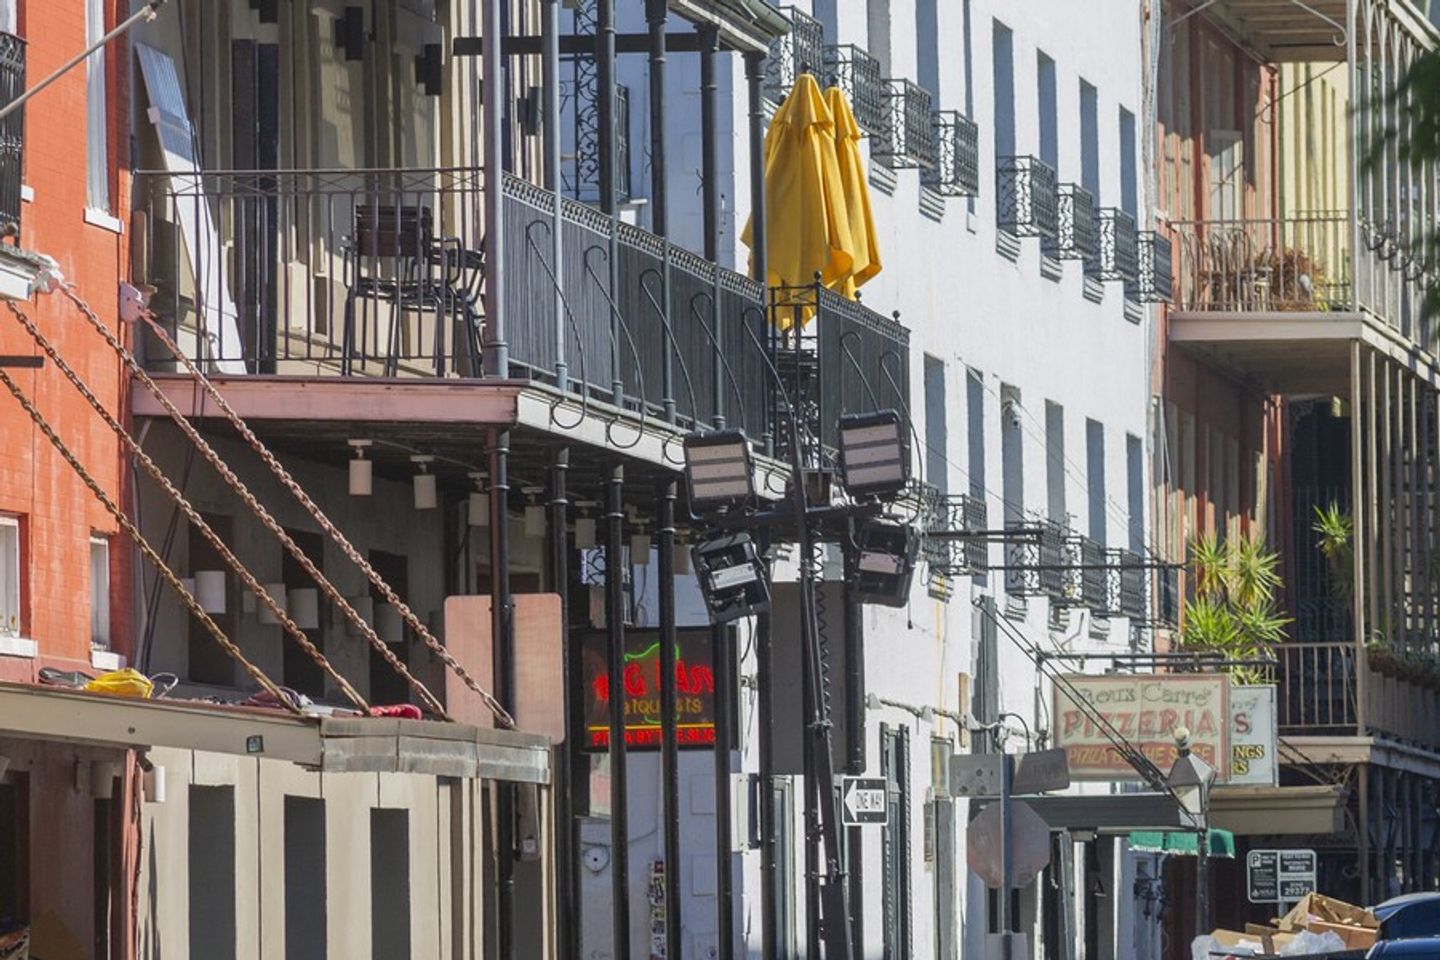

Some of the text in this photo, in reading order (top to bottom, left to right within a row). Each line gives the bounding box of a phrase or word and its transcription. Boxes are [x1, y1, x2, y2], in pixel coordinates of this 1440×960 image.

[1063, 708, 1215, 738] PIZZERIA
[1070, 747, 1108, 765] PIZZA
[856, 792, 882, 810] ONE WAY
